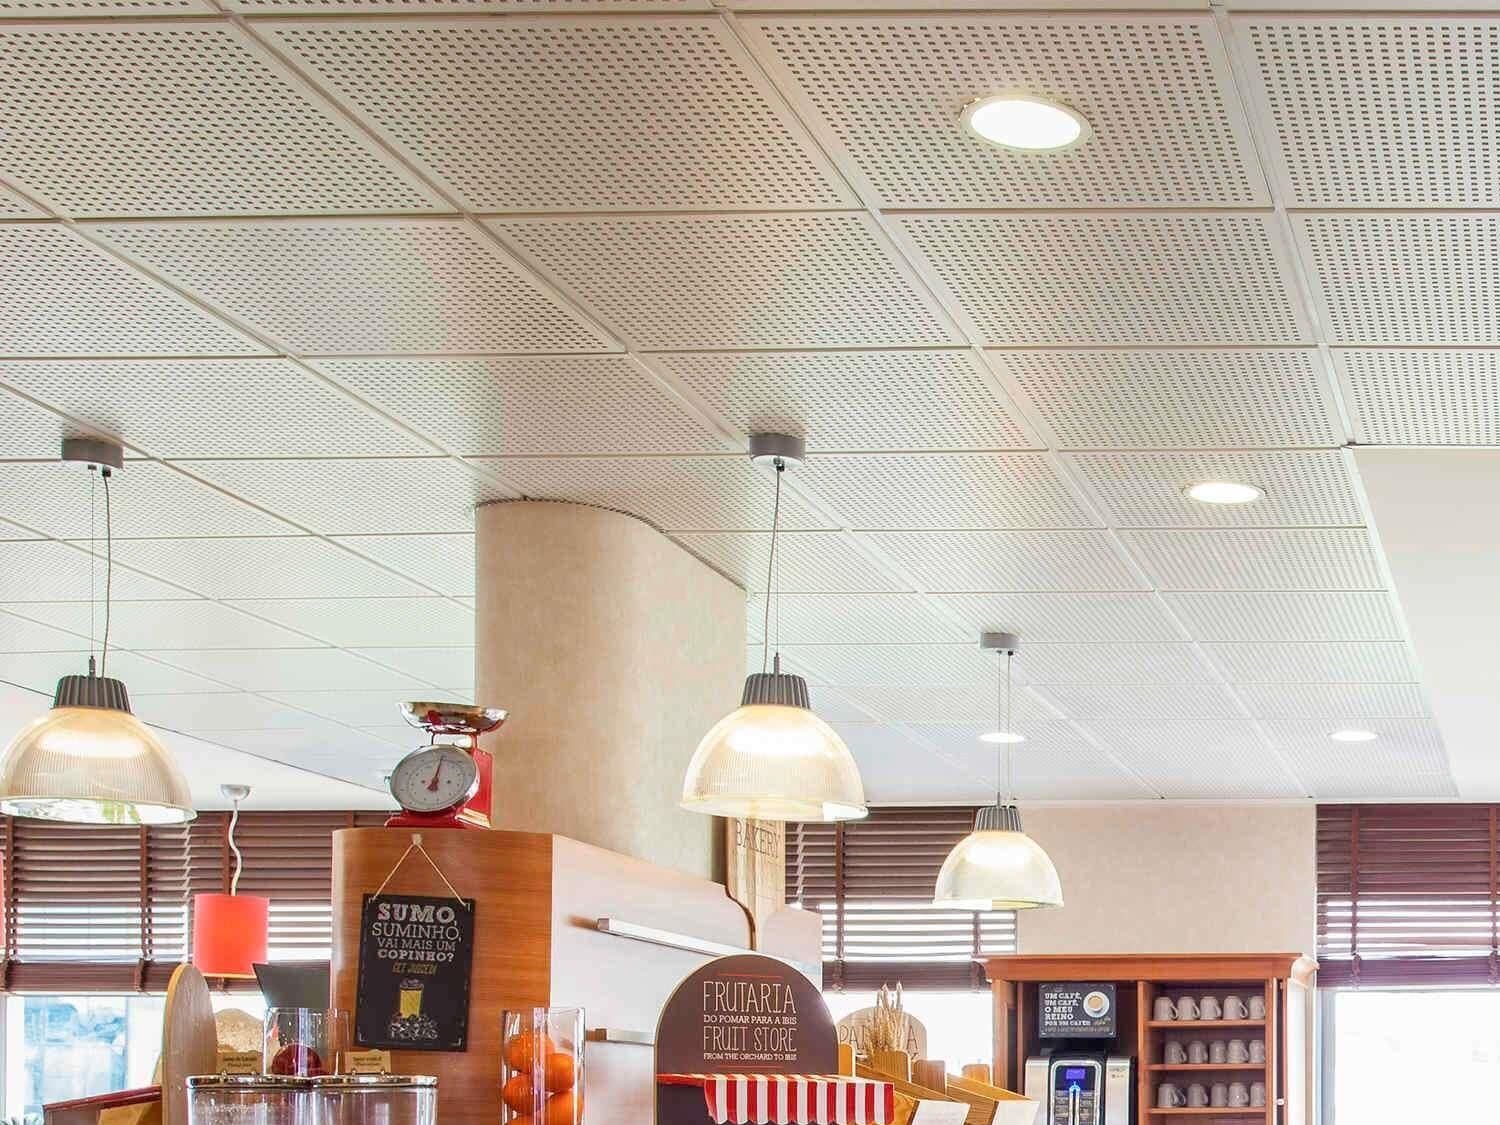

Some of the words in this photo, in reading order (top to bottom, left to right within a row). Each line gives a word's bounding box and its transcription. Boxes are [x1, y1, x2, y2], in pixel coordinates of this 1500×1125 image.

[377, 902, 458, 926] SUMO,
[371, 922, 462, 942] SUMINHO,
[377, 937, 398, 949] VAI
[401, 939, 433, 951] MAIS
[436, 941, 456, 952] UM
[377, 949, 455, 962] COPINHO?
[703, 980, 797, 1014] FRUTARIA
[703, 1014, 718, 1023] DO
[719, 1014, 750, 1024] POMAR
[751, 1015, 773, 1025] PARA
[774, 1016, 781, 1025] A
[782, 1016, 798, 1025] IBIS
[703, 1025, 749, 1052] FRUIT
[753, 1026, 798, 1052] STORE
[703, 1052, 724, 1060] FROM
[739, 1053, 773, 1061] ORCHARD
[774, 1053, 784, 1061] TO
